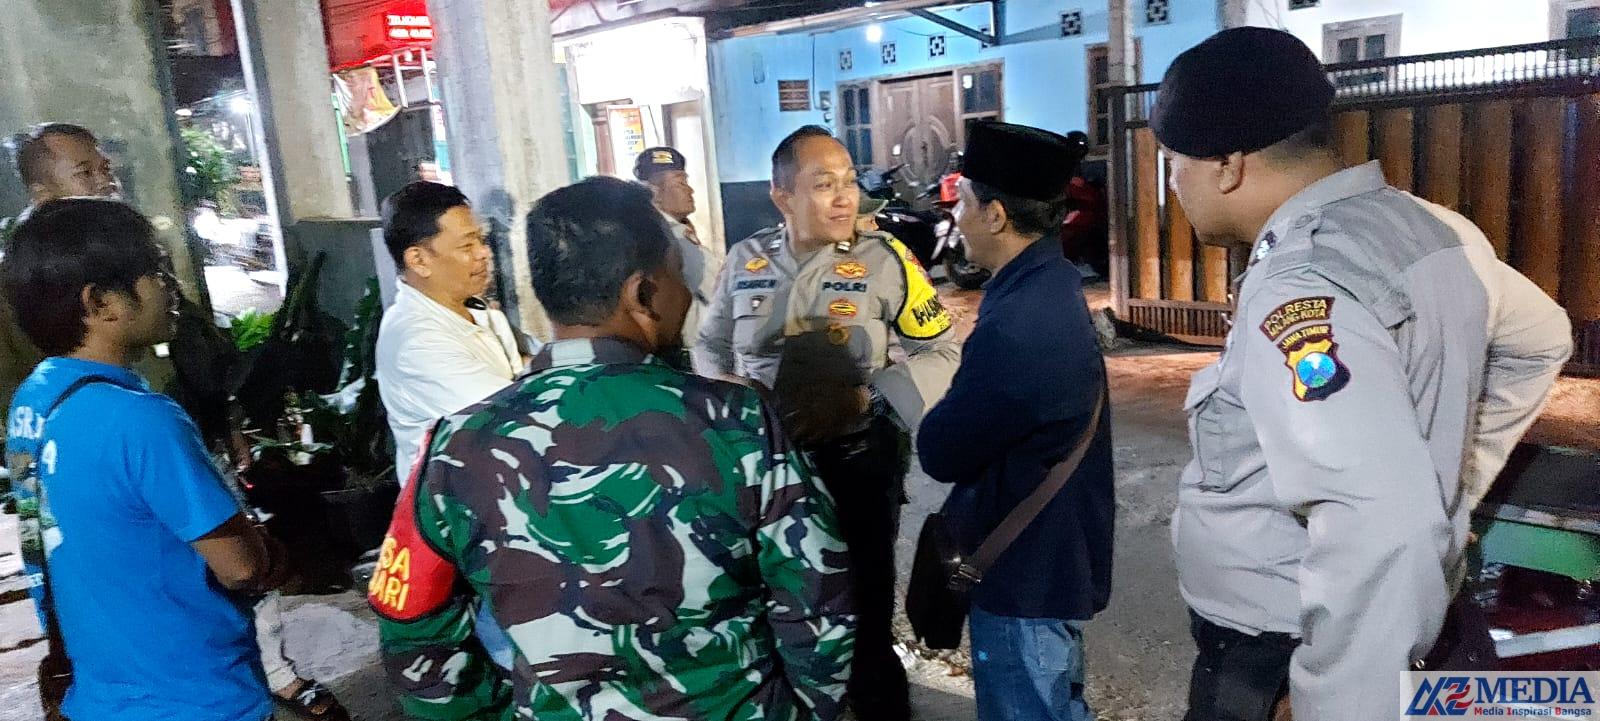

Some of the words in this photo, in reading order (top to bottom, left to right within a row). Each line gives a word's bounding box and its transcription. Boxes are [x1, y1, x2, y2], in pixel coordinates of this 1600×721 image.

[822, 282, 867, 292] POLRI
[1264, 300, 1327, 331] POLRESTA
[1301, 308, 1325, 319] KOTA
[1282, 331, 1301, 348] JAWA
[1302, 326, 1328, 336] TIMUR
[378, 537, 410, 580] SA
